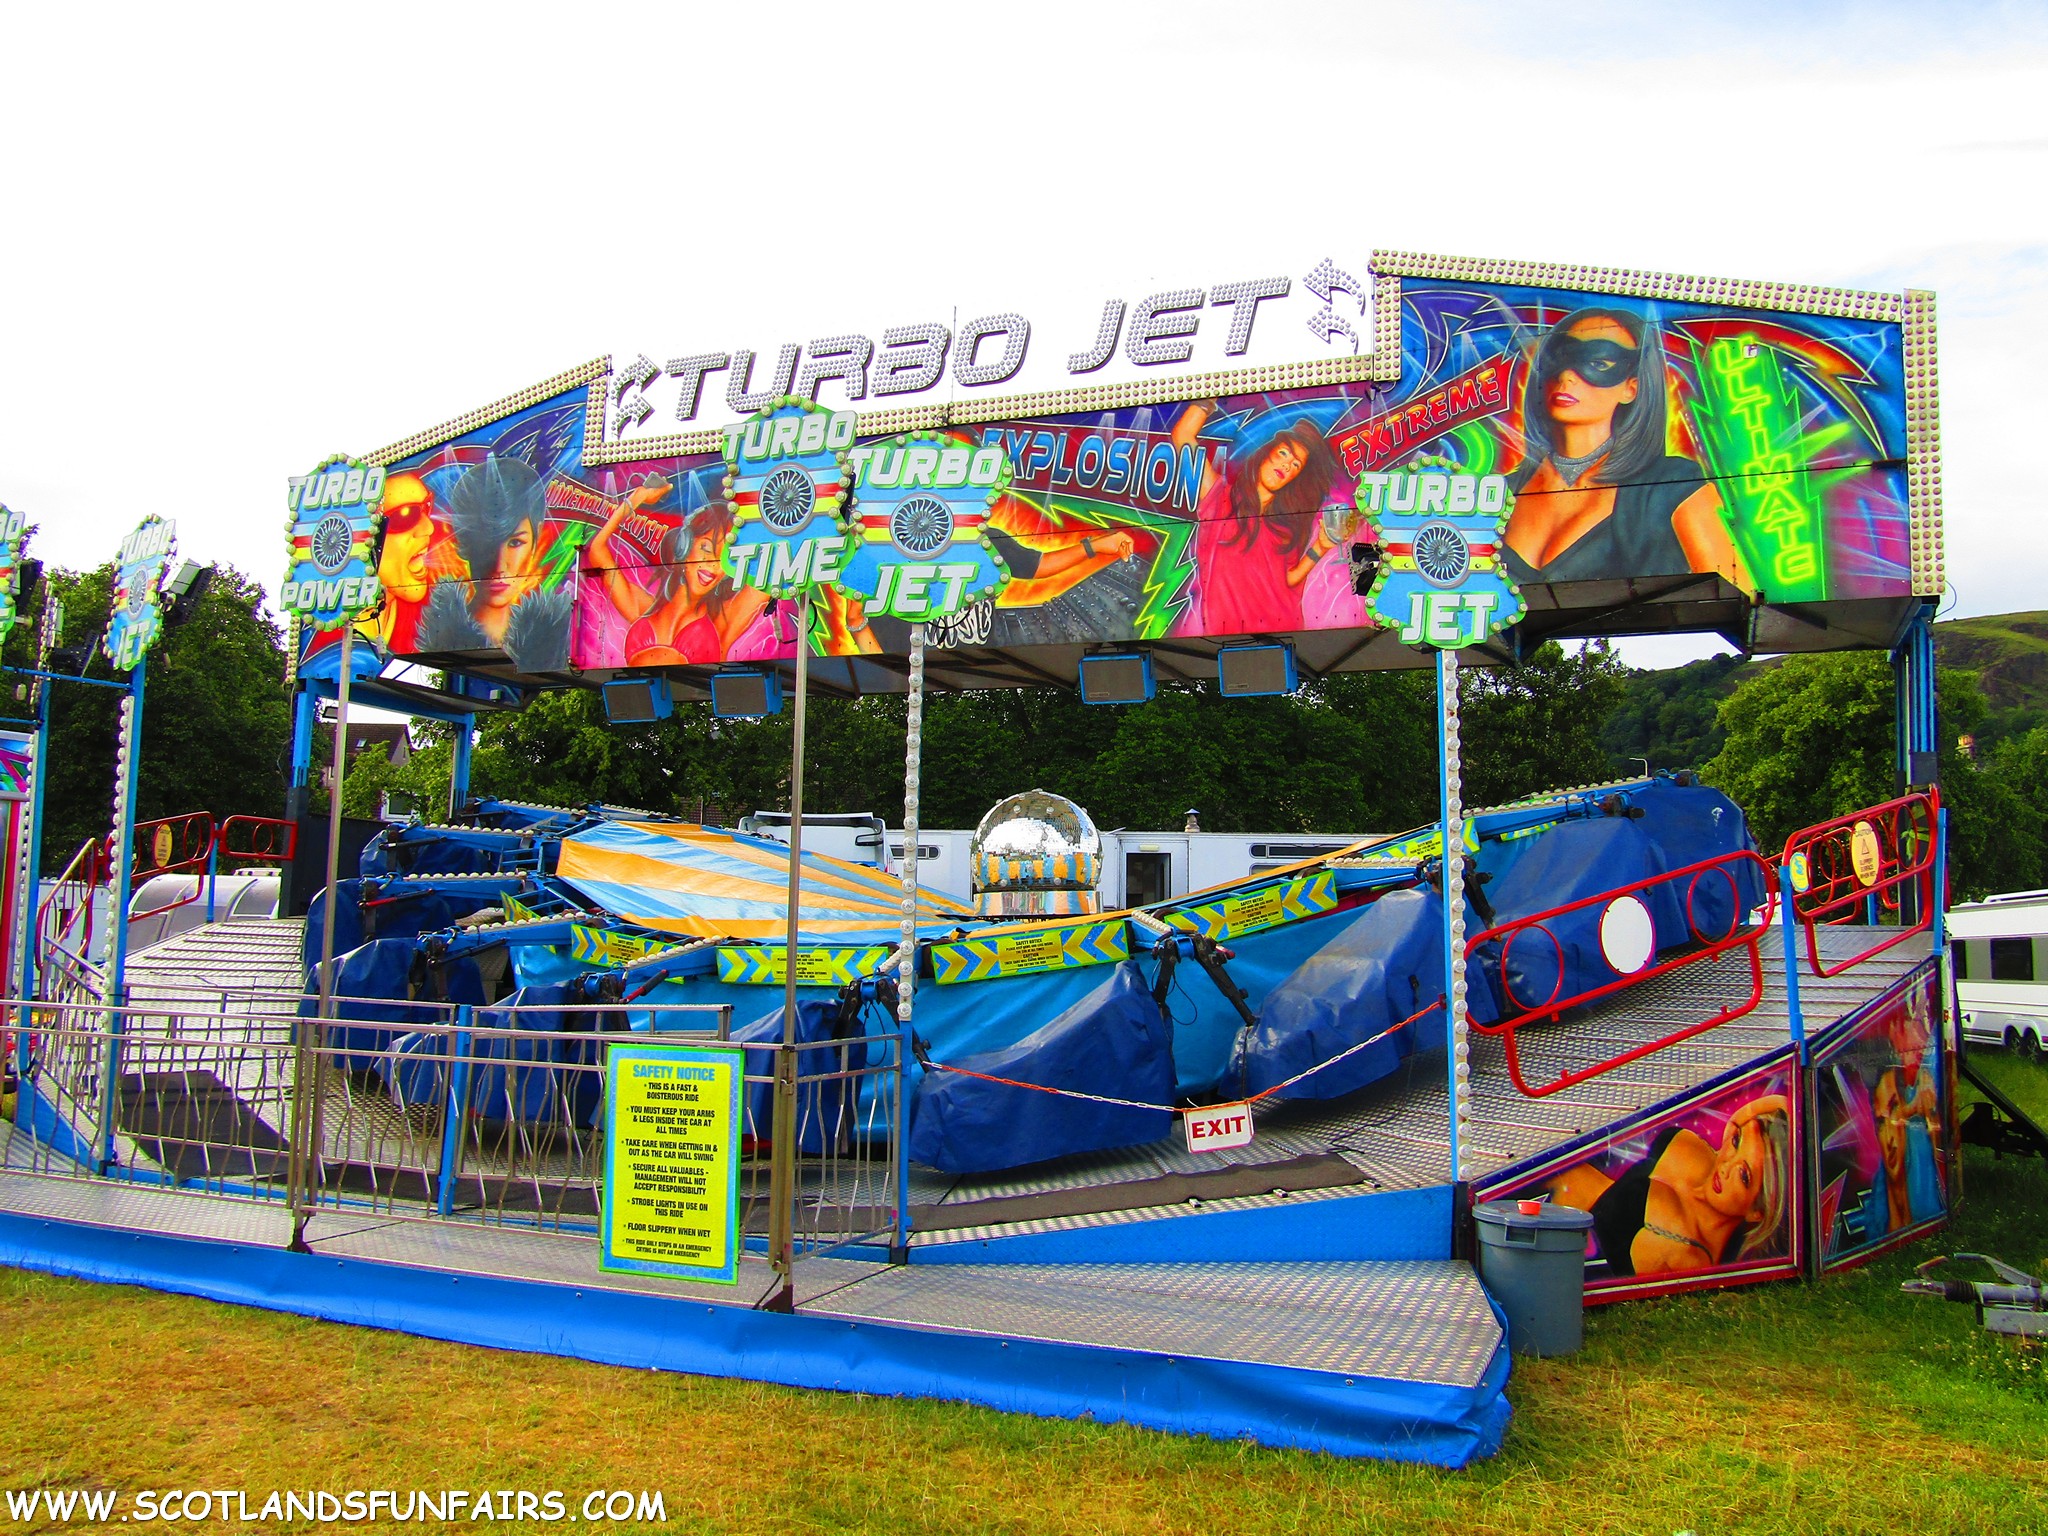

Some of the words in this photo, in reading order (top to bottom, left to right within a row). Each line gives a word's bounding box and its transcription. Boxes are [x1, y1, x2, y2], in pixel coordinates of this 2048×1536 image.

[665, 312, 1032, 420] TURBO
[1066, 275, 1292, 375] JET
[722, 410, 857, 463] TURBO
[1341, 367, 1501, 481] EXTREME
[847, 448, 1005, 489] TURBO
[1713, 337, 1815, 584] ULTIMATE
[288, 466, 386, 511] TURBO
[1363, 474, 1507, 515] TURBO
[121, 519, 176, 566] TURBO
[619, 513, 670, 556] RUSH
[728, 536, 848, 592] TIME
[280, 575, 380, 611] POWER
[863, 563, 977, 618] JET
[1400, 593, 1499, 643] JET
[633, 1064, 673, 1078] SAFETY
[677, 1067, 715, 1081] NOTICE
[647, 1092, 683, 1100] BOISTEROUS
[669, 1127, 687, 1135] TIMES
[1191, 1116, 1246, 1139] EXIT
[659, 1141, 677, 1149] WHEN
[679, 1142, 703, 1151] GETTING
[694, 1153, 713, 1161] SWING
[633, 1163, 655, 1171] SECURE
[657, 1165, 668, 1173] ALL
[669, 1166, 704, 1175] VALUABLES
[635, 1173, 676, 1183] MANAGEMENT
[678, 1176, 692, 1184] WILL
[632, 1198, 654, 1206] STROBE
[656, 1200, 676, 1208] LIGHTS
[678, 1201, 684, 1209] IN
[686, 1202, 697, 1210] USE
[699, 1203, 708, 1211] ON
[634, 1182, 657, 1191] ACCEPT
[658, 1185, 706, 1195] RESPONSIBILITY
[628, 1223, 646, 1231] FLOOR
[648, 1224, 677, 1234] SLIPPERY
[678, 1228, 695, 1236] WHEN
[698, 1229, 710, 1237] WET
[655, 1208, 668, 1216] THIS
